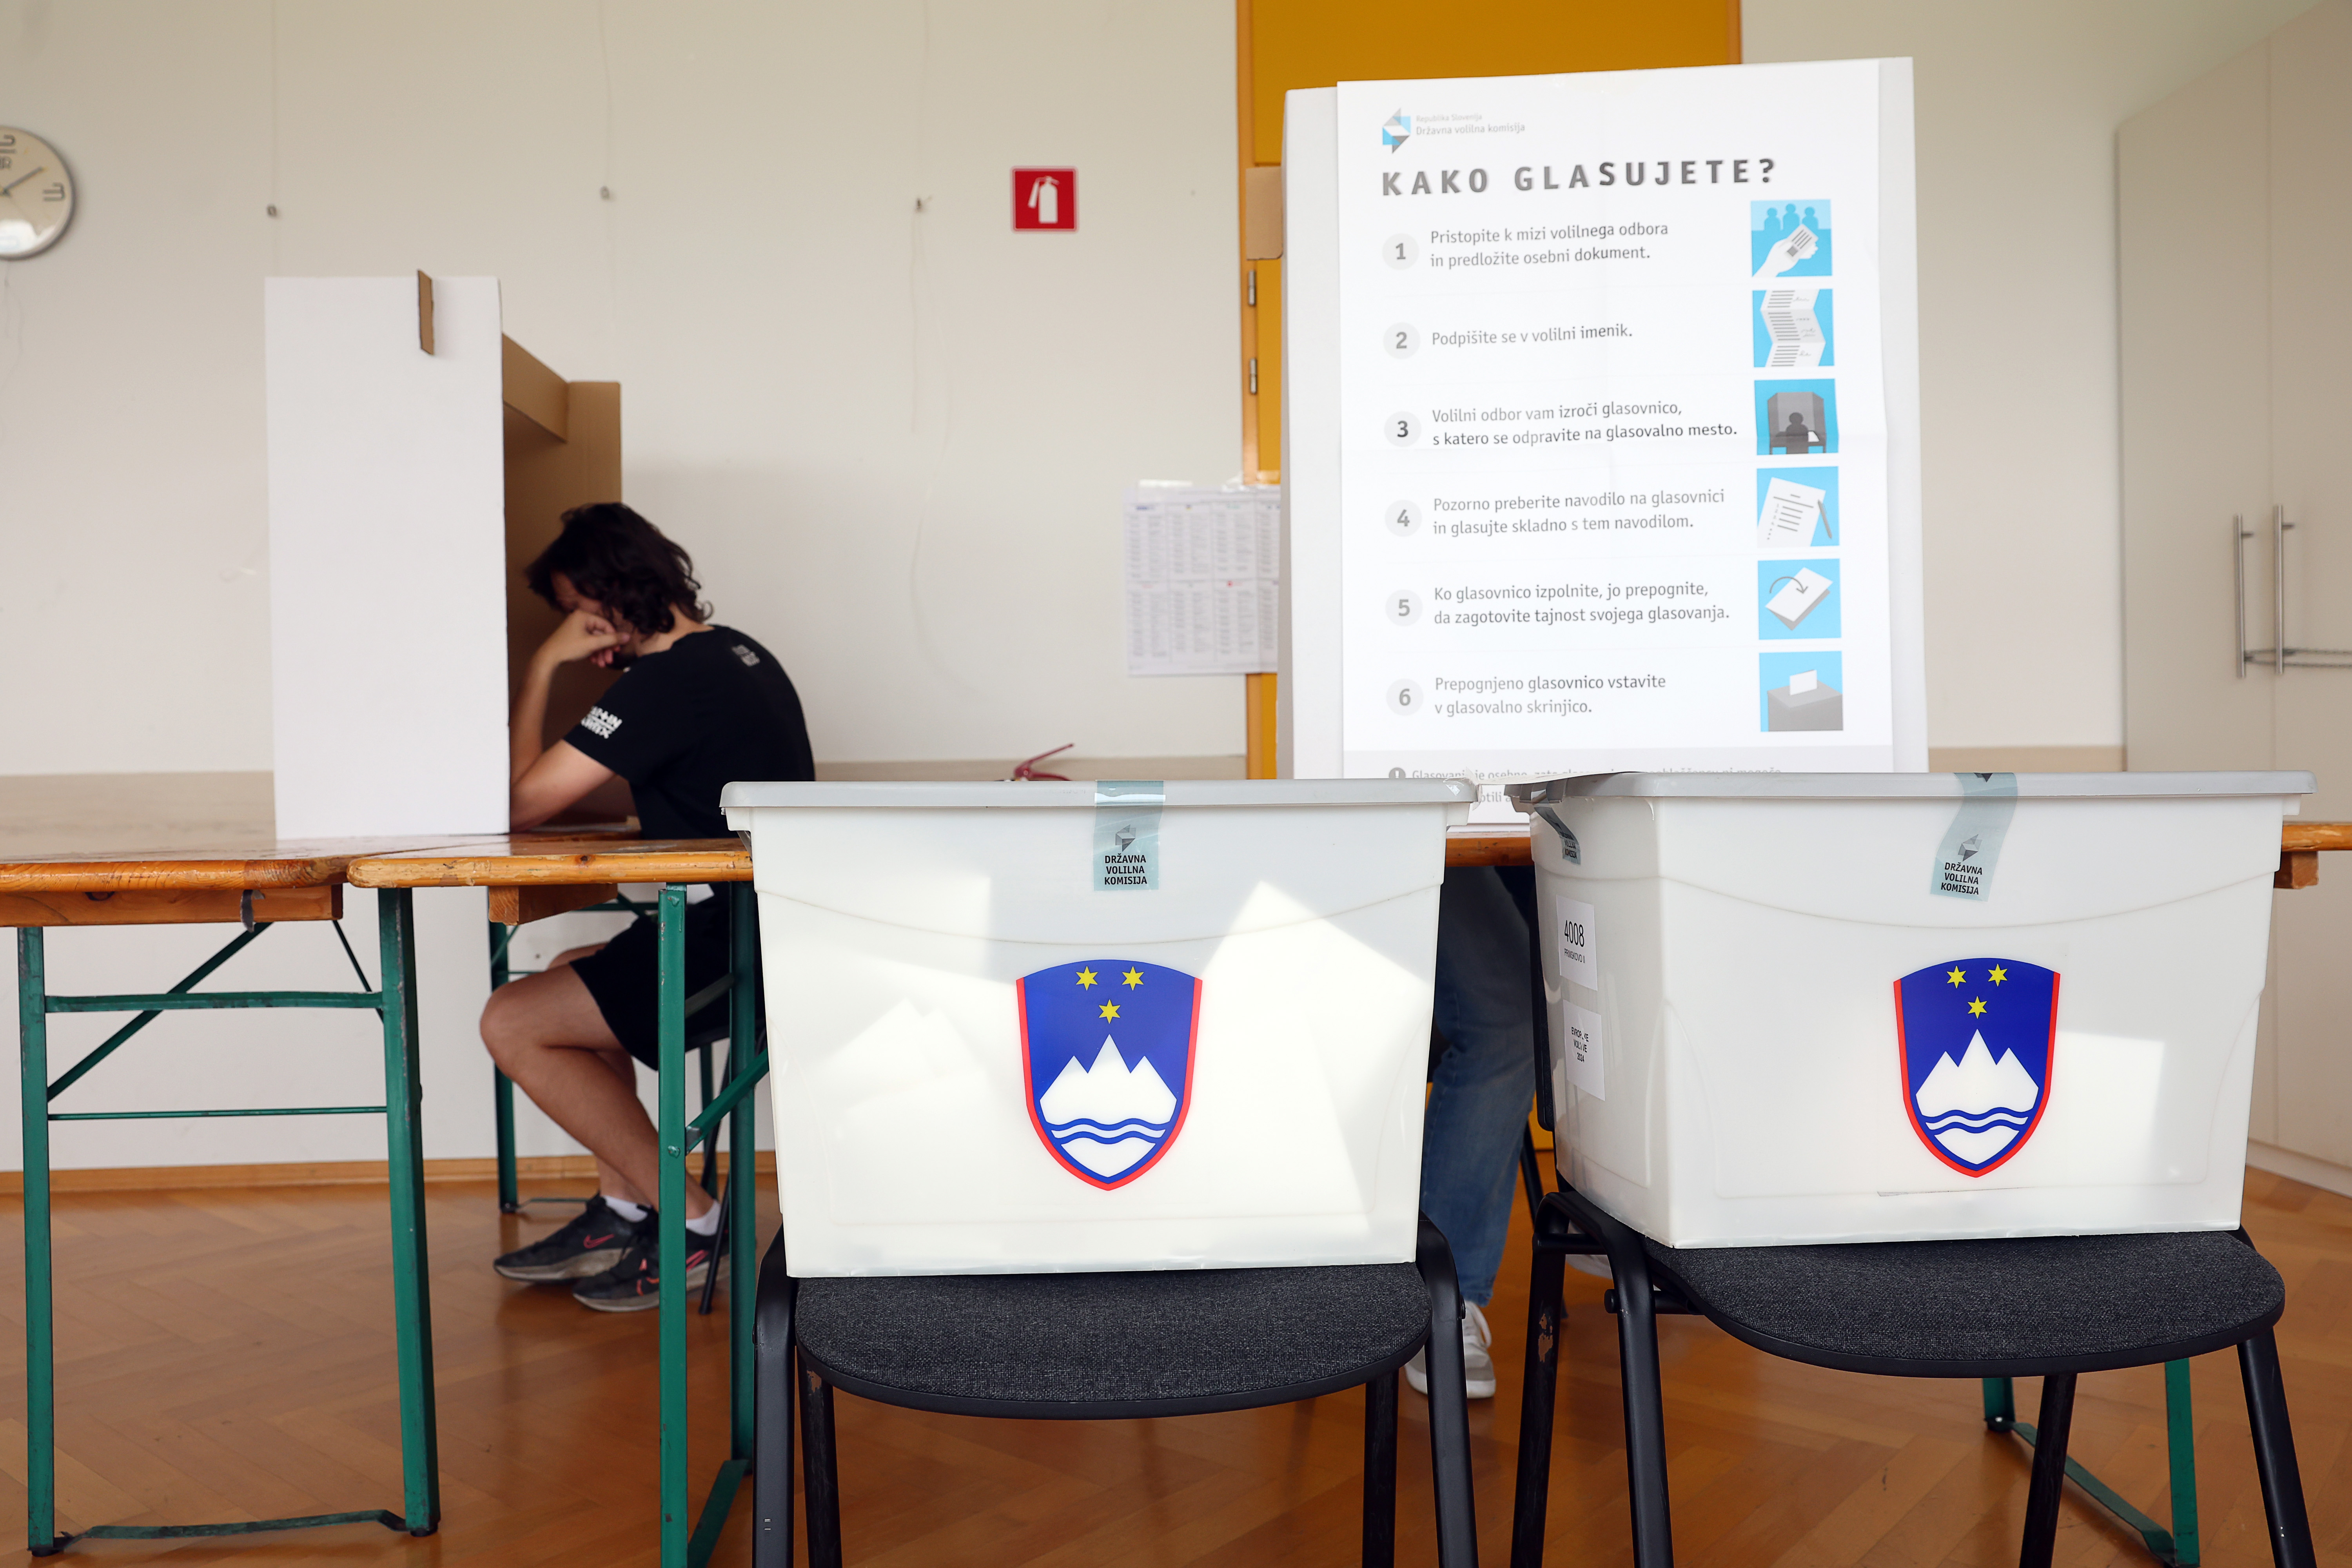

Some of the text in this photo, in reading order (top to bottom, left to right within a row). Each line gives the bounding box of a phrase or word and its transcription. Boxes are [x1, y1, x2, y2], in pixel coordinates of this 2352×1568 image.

[1416, 113, 1483, 124] Republika Slovenija
[1416, 122, 1526, 136] Državna volilna komisija
[1383, 158, 1775, 196] KAKO GLASUJETE?
[1432, 222, 1668, 246] Pristopite k mizi volilnega odbora
[1396, 243, 1406, 260] 1
[1431, 247, 1651, 270] in predložite osebni dokument.
[1396, 332, 1407, 349] 2
[1433, 323, 1633, 348] Podpišite se v volilni imenik.
[1432, 401, 1682, 423] Volilni odbor vam izroči glasovnico,
[1397, 421, 1408, 437] 3
[1434, 424, 1738, 447] s katero se odpravite na glasovalno mesto.
[1435, 489, 1724, 514] Pozorno preberite navodilo na glasovnici
[1397, 509, 1410, 527] 4
[1434, 514, 1694, 538] in glasujte skladno s tem navodilom.
[1435, 582, 1708, 604] Ko glasovnico izpolnite, jo prepognite,
[1399, 599, 1410, 617] 5
[1435, 605, 1730, 627] da zagotovite tajnost svojega glasovanja.
[1436, 674, 1666, 694] Prepognjeno glasovnico vstavite
[1399, 688, 1411, 706] 6
[1435, 699, 1592, 718] v glasovalno skrinjico.
[1105, 853, 1146, 864] DRŽAVNA
[1106, 866, 1145, 874] VOLILNA
[1944, 862, 1982, 875] DRŽAVNA
[1104, 876, 1147, 885] KOMISIJA
[1945, 872, 1979, 885] VOLILNA
[1941, 882, 1979, 895] KOMISIJA
[1564, 920, 1584, 947] 4008
[1564, 948, 1583, 963] PRIMSKOVO
[1571, 1026, 1589, 1042] EVROPKE
